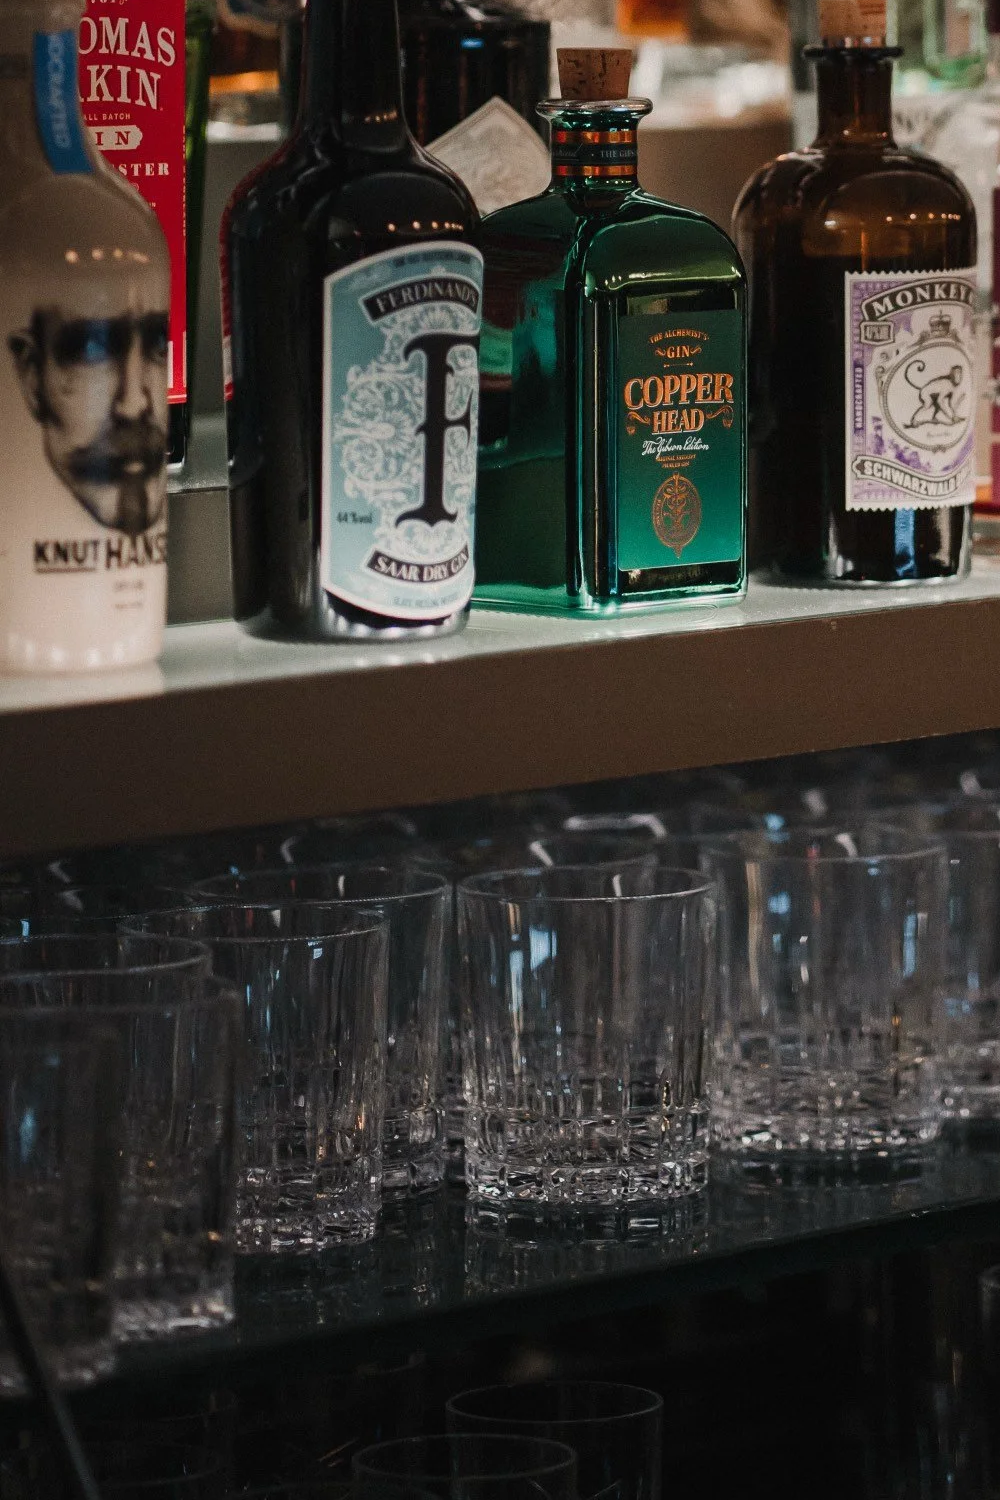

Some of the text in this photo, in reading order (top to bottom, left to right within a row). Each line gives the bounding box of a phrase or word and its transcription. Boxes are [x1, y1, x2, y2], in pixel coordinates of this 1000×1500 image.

[80, 64, 161, 110] KIN
[113, 163, 169, 177] STER
[872, 283, 968, 317] MONKEY
[649, 331, 663, 344] THE
[666, 345, 690, 359] GIN
[623, 371, 735, 411] COPPER
[395, 332, 480, 528] F
[651, 408, 706, 435] HEAD
[641, 440, 657, 455] The
[683, 435, 710, 451] Edition
[34, 538, 100, 565] KNUT
[374, 552, 420, 586] SAAR
[422, 563, 451, 582] DRY
